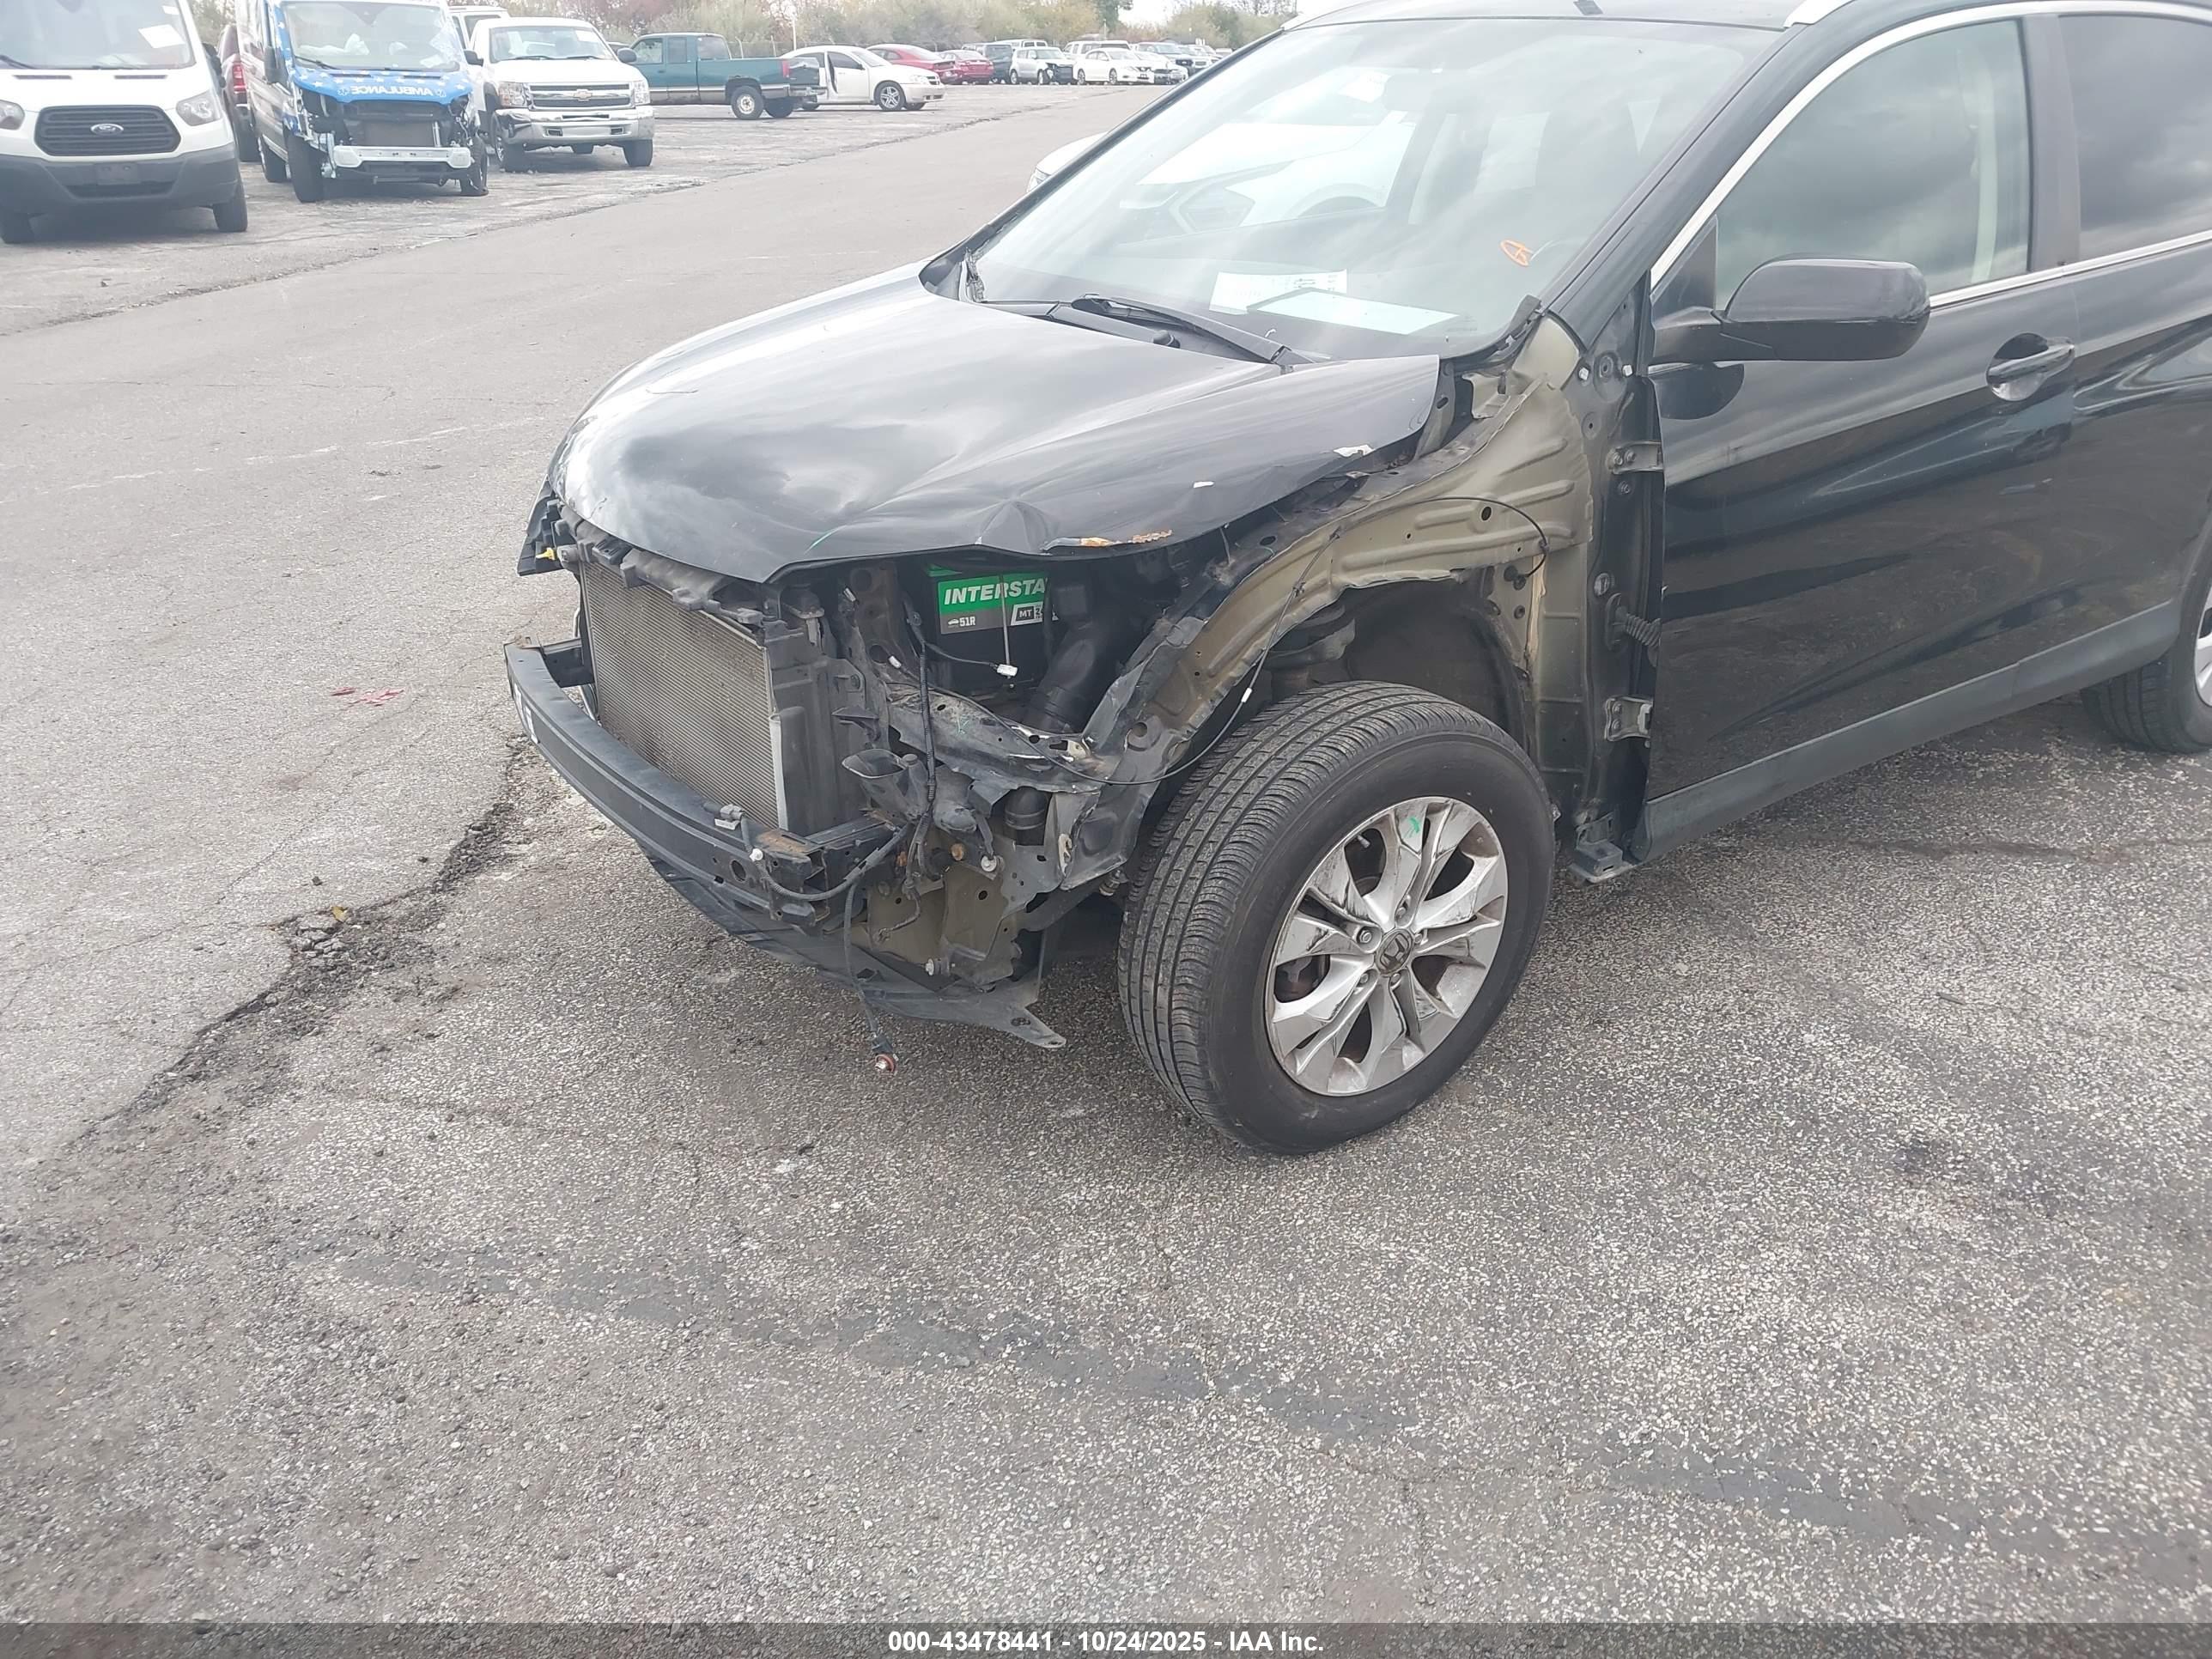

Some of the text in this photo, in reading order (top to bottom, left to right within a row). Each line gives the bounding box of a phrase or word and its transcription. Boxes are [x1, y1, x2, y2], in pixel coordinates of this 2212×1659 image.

[944, 578, 1047, 605] INTERSTA
[1019, 609, 1033, 618] MT
[959, 616, 975, 627] 51R
